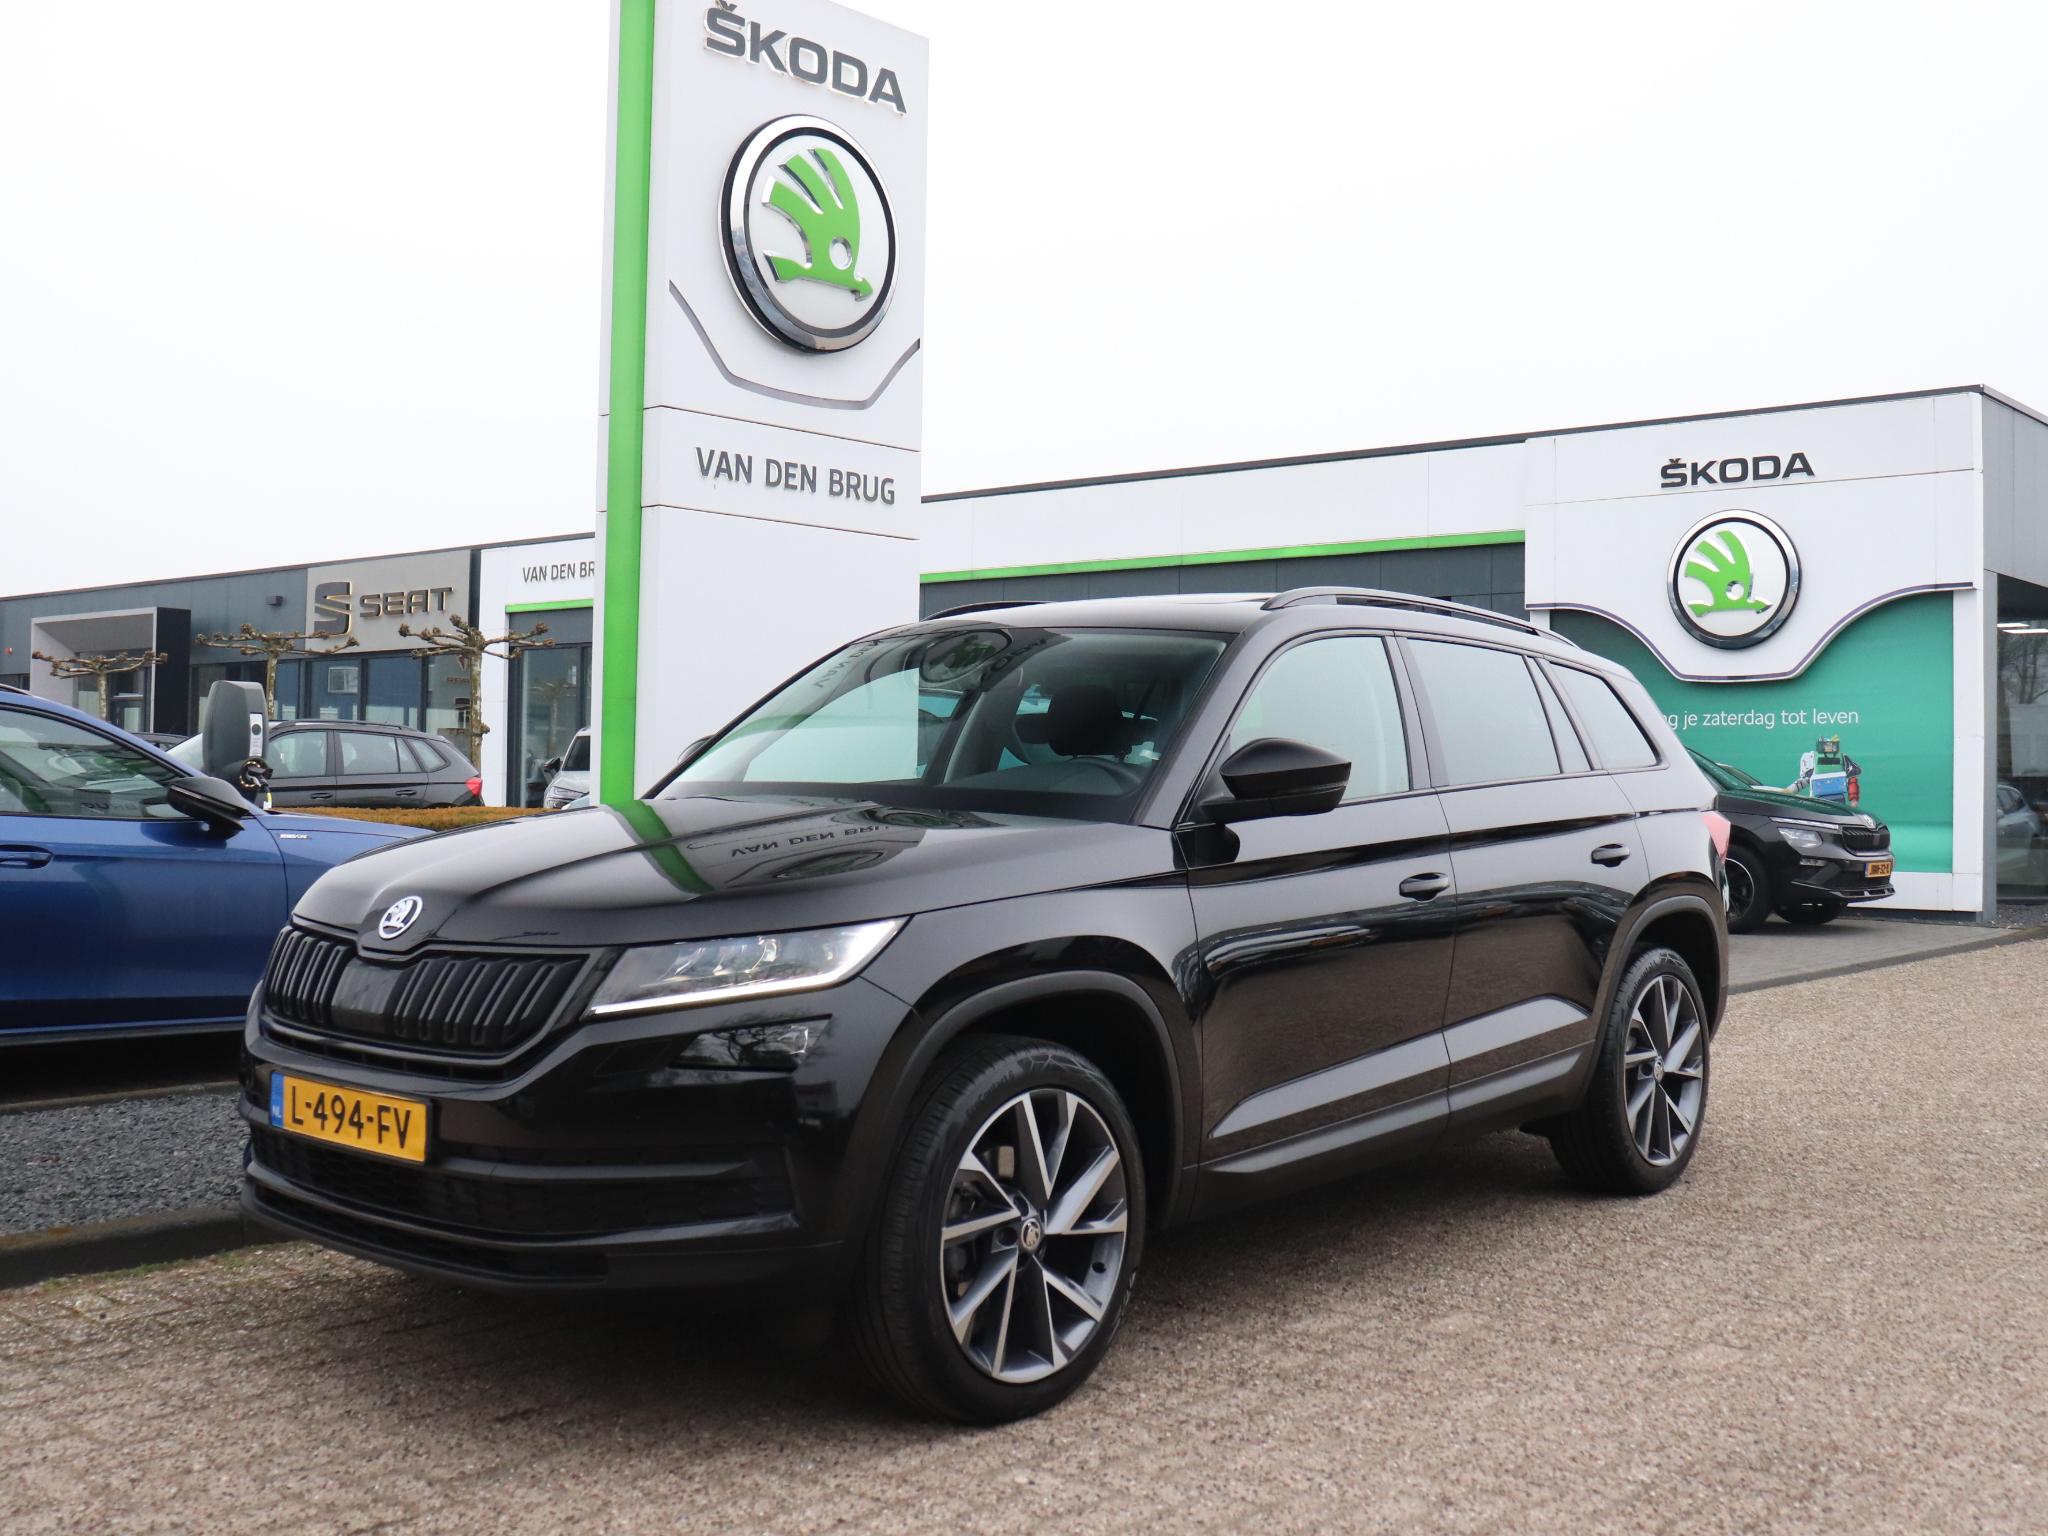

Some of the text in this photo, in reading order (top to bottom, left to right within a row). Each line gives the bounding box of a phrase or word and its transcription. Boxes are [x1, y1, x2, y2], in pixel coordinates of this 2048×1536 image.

[704, 0, 907, 115] ŠKODA
[695, 446, 895, 505] VAN DEN BRUG
[1660, 452, 1815, 488] ŠKODA
[522, 565, 547, 583] VAN
[550, 563, 576, 581] DEN
[359, 586, 453, 618] SEAT
[1683, 711, 1698, 730] je
[1702, 709, 1775, 729] zaterdag
[1780, 710, 1807, 725] tot
[1812, 708, 1859, 724] leven
[291, 1085, 411, 1149] L-494-FV
